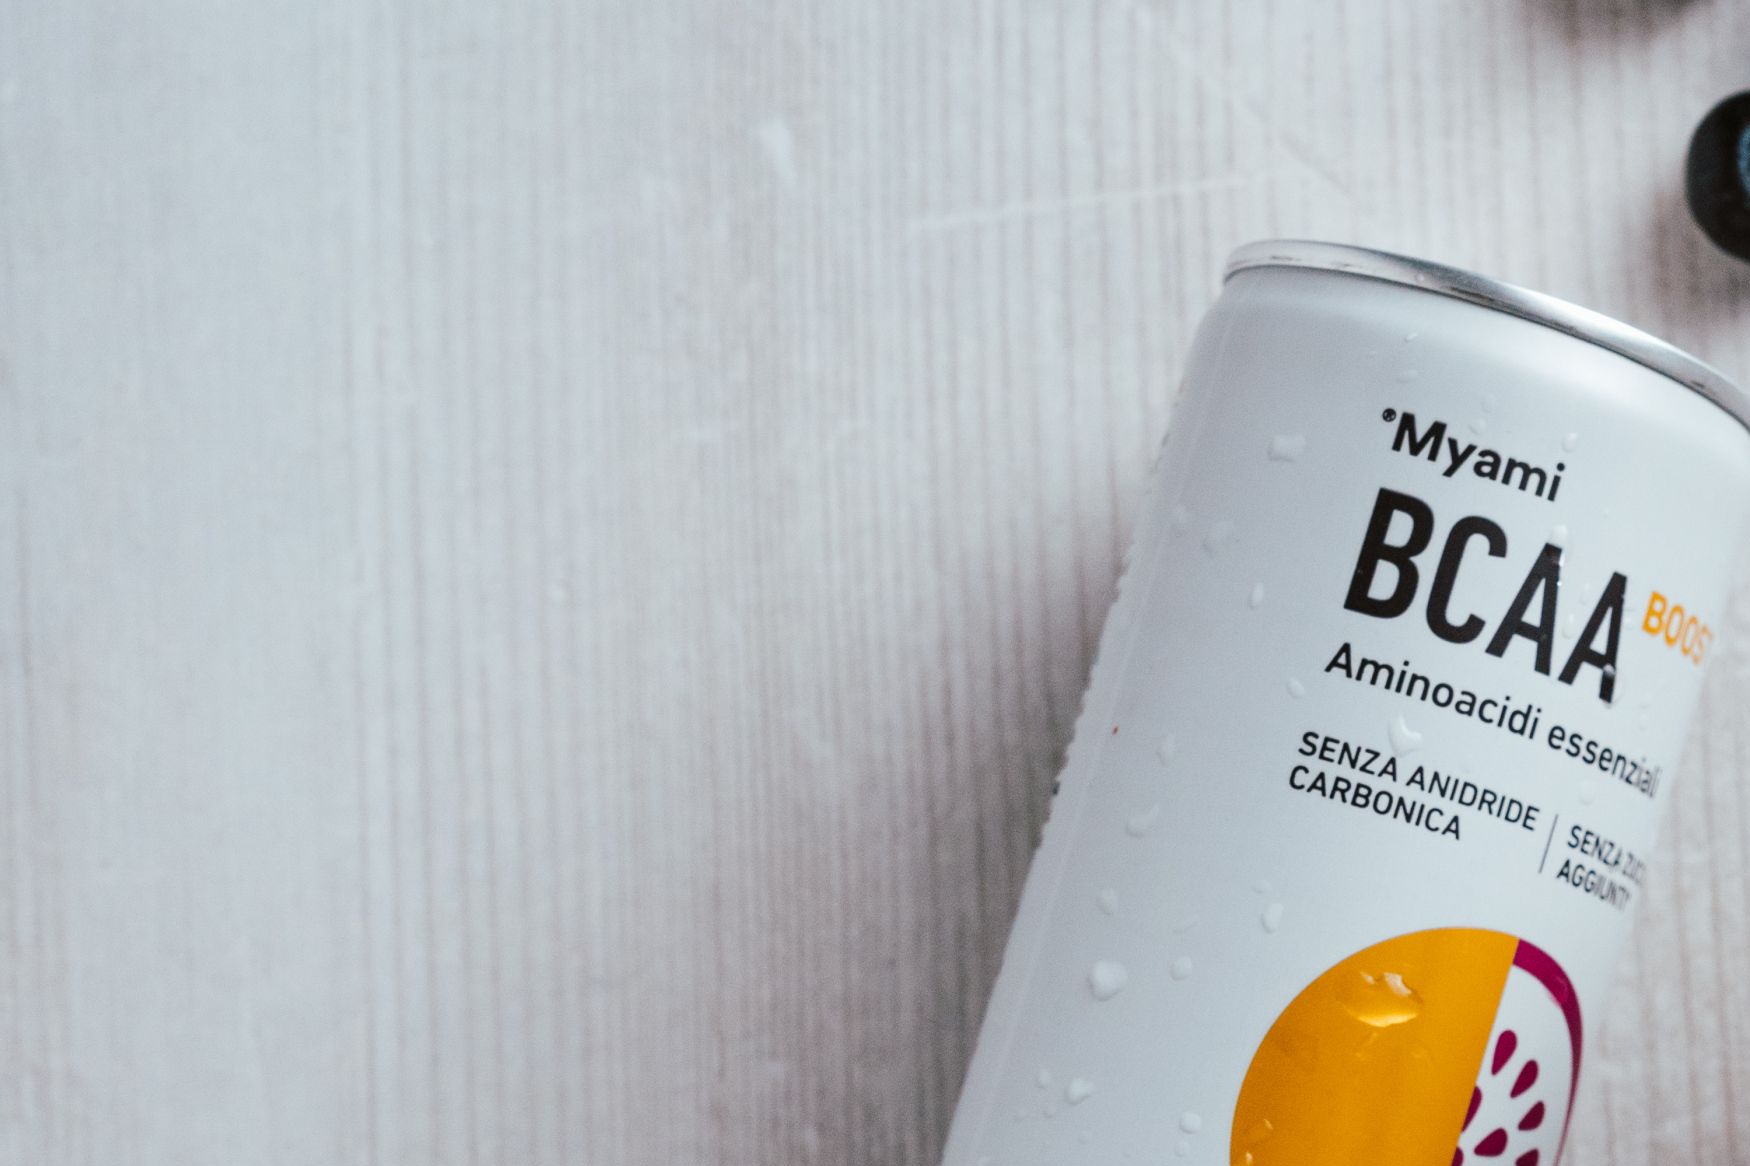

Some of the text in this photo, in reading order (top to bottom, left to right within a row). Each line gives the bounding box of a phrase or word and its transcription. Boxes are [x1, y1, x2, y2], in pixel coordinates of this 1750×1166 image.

[1343, 486, 1628, 704] BCAA
[1324, 642, 1543, 740] Aminoacidi
[1288, 764, 1461, 841] CARBONICA
[1297, 731, 1541, 832] SENZA ANIDRIDE
